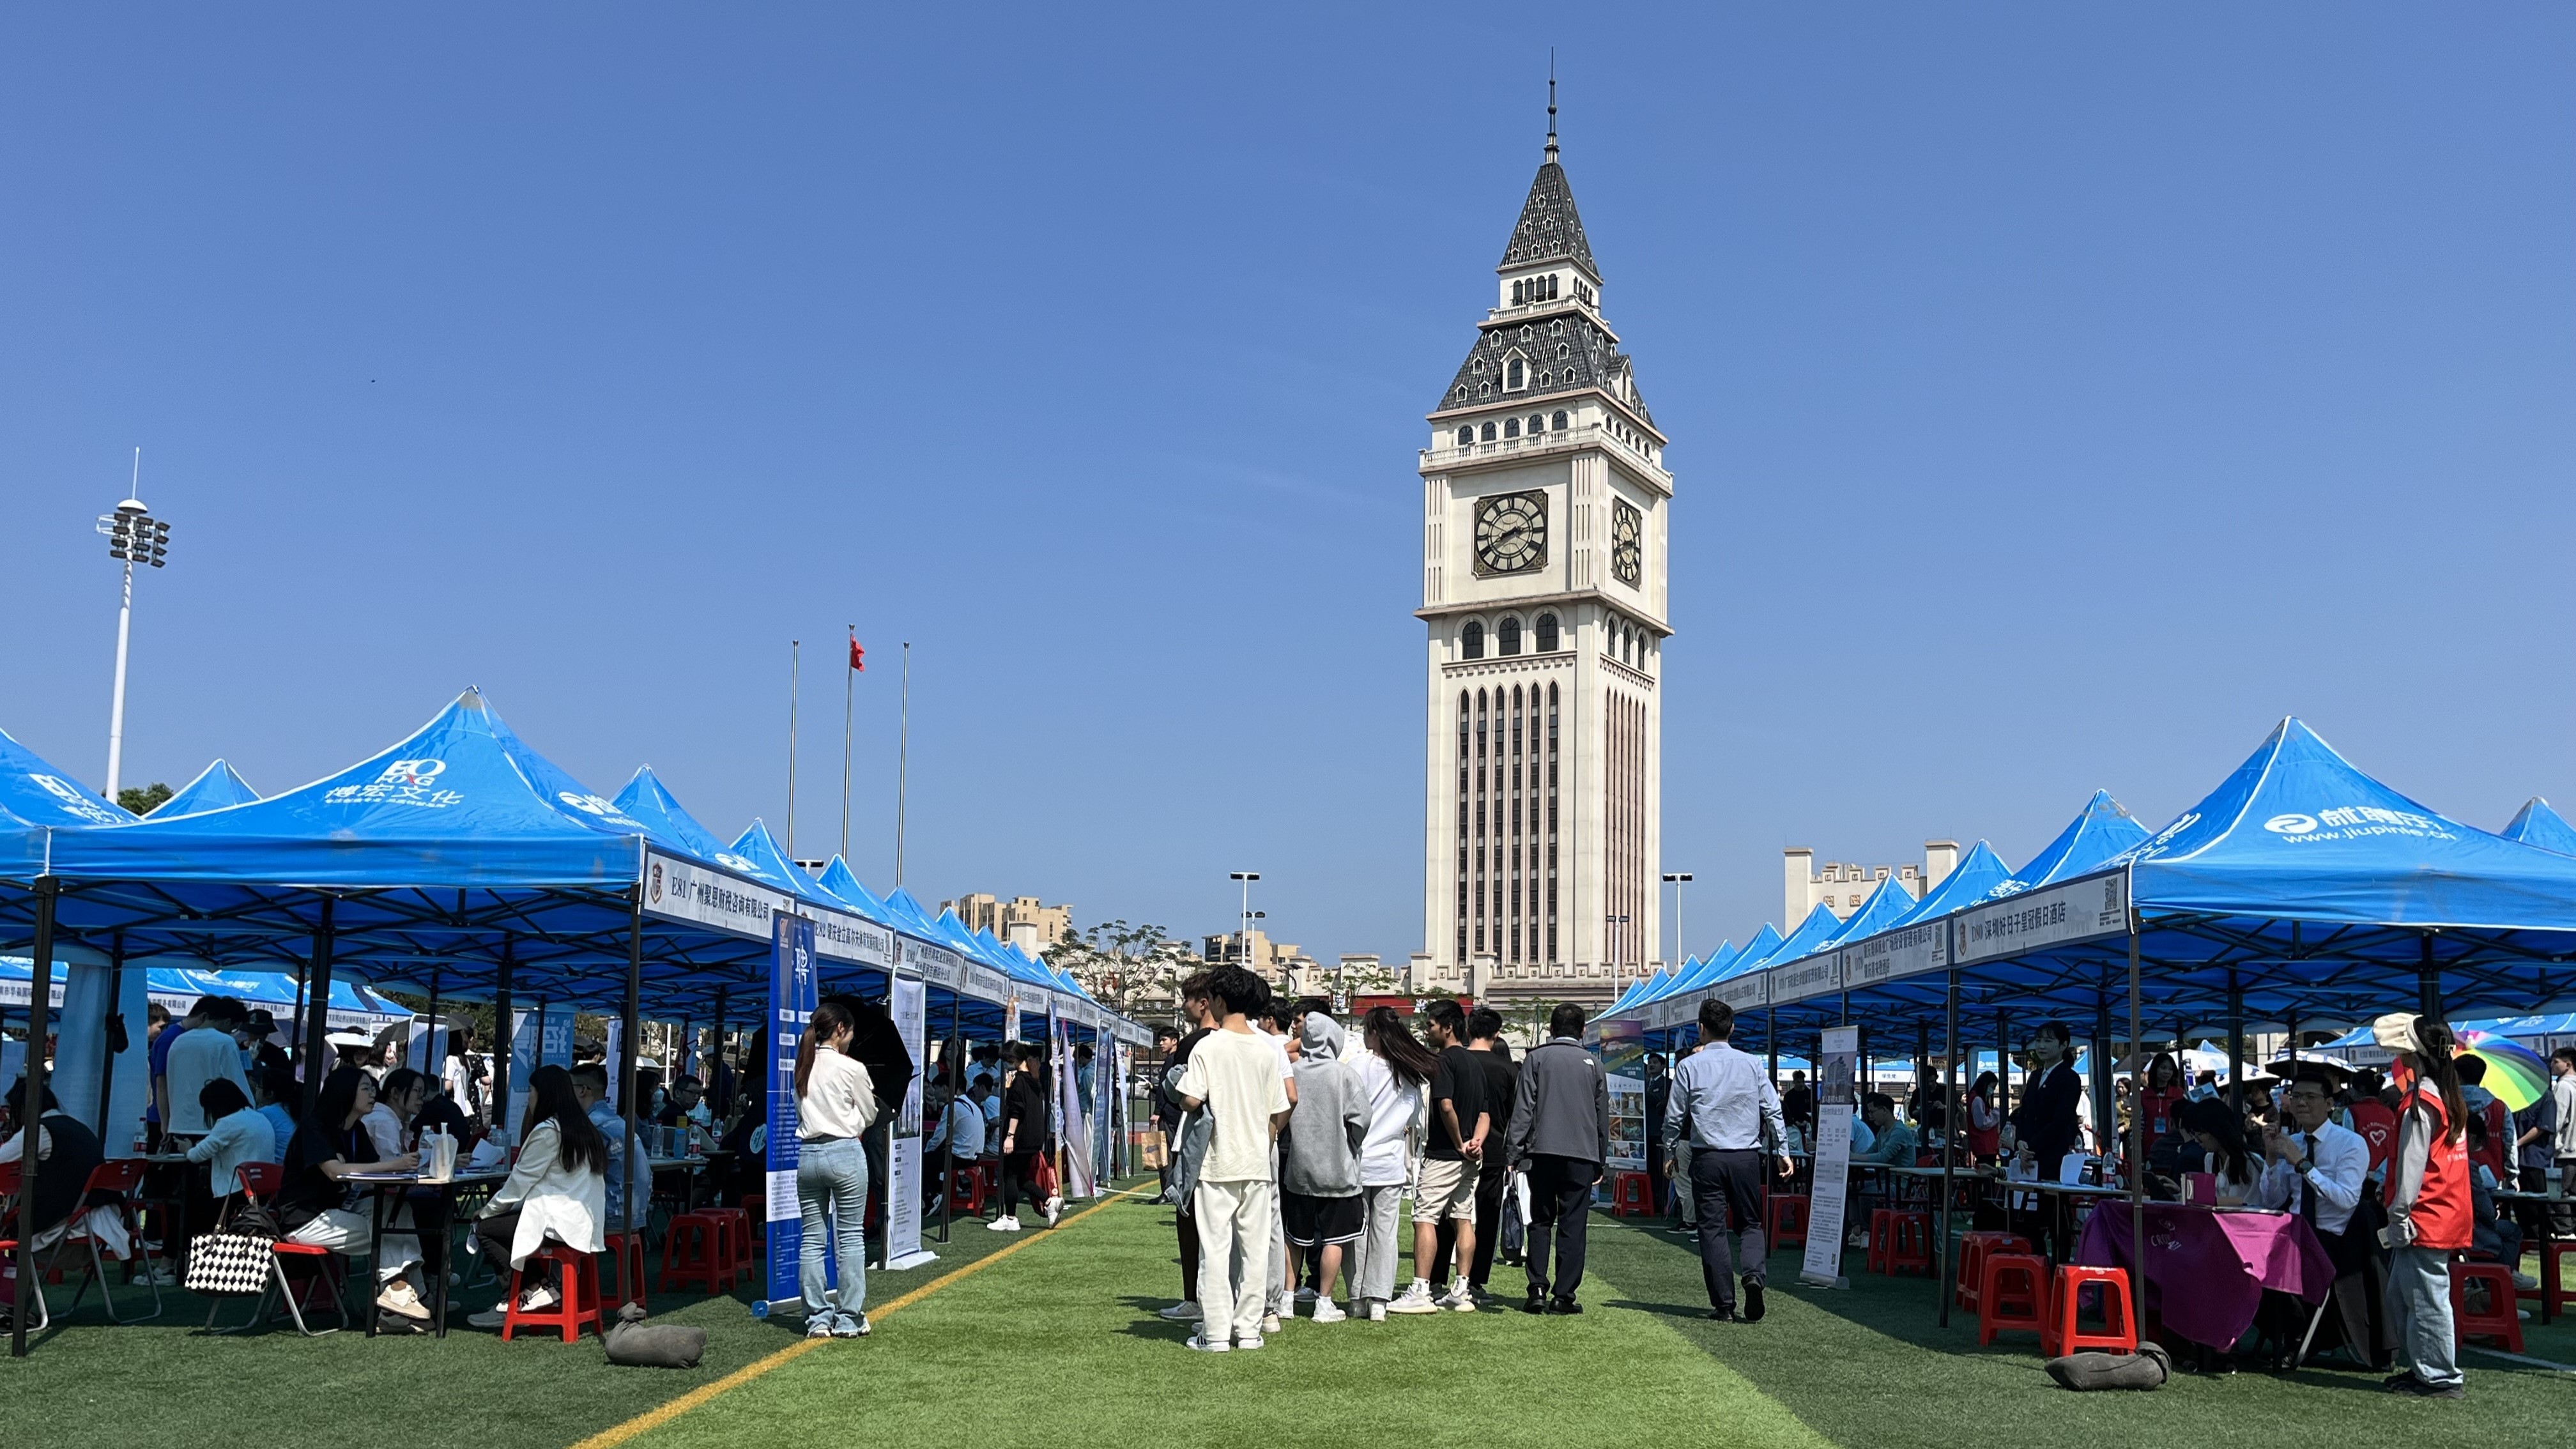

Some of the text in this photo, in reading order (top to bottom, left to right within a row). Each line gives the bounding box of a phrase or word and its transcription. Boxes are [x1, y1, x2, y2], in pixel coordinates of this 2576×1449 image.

[325, 784, 464, 805] 博宏文化
[671, 877, 769, 922] E81 广州聚恩财税咨询有限公司
[815, 922, 826, 938] E82
[1972, 925, 1982, 942] D80
[1984, 901, 2066, 940] 深圳好日子皇冠假日酒店
[795, 944, 809, 985] 聘
